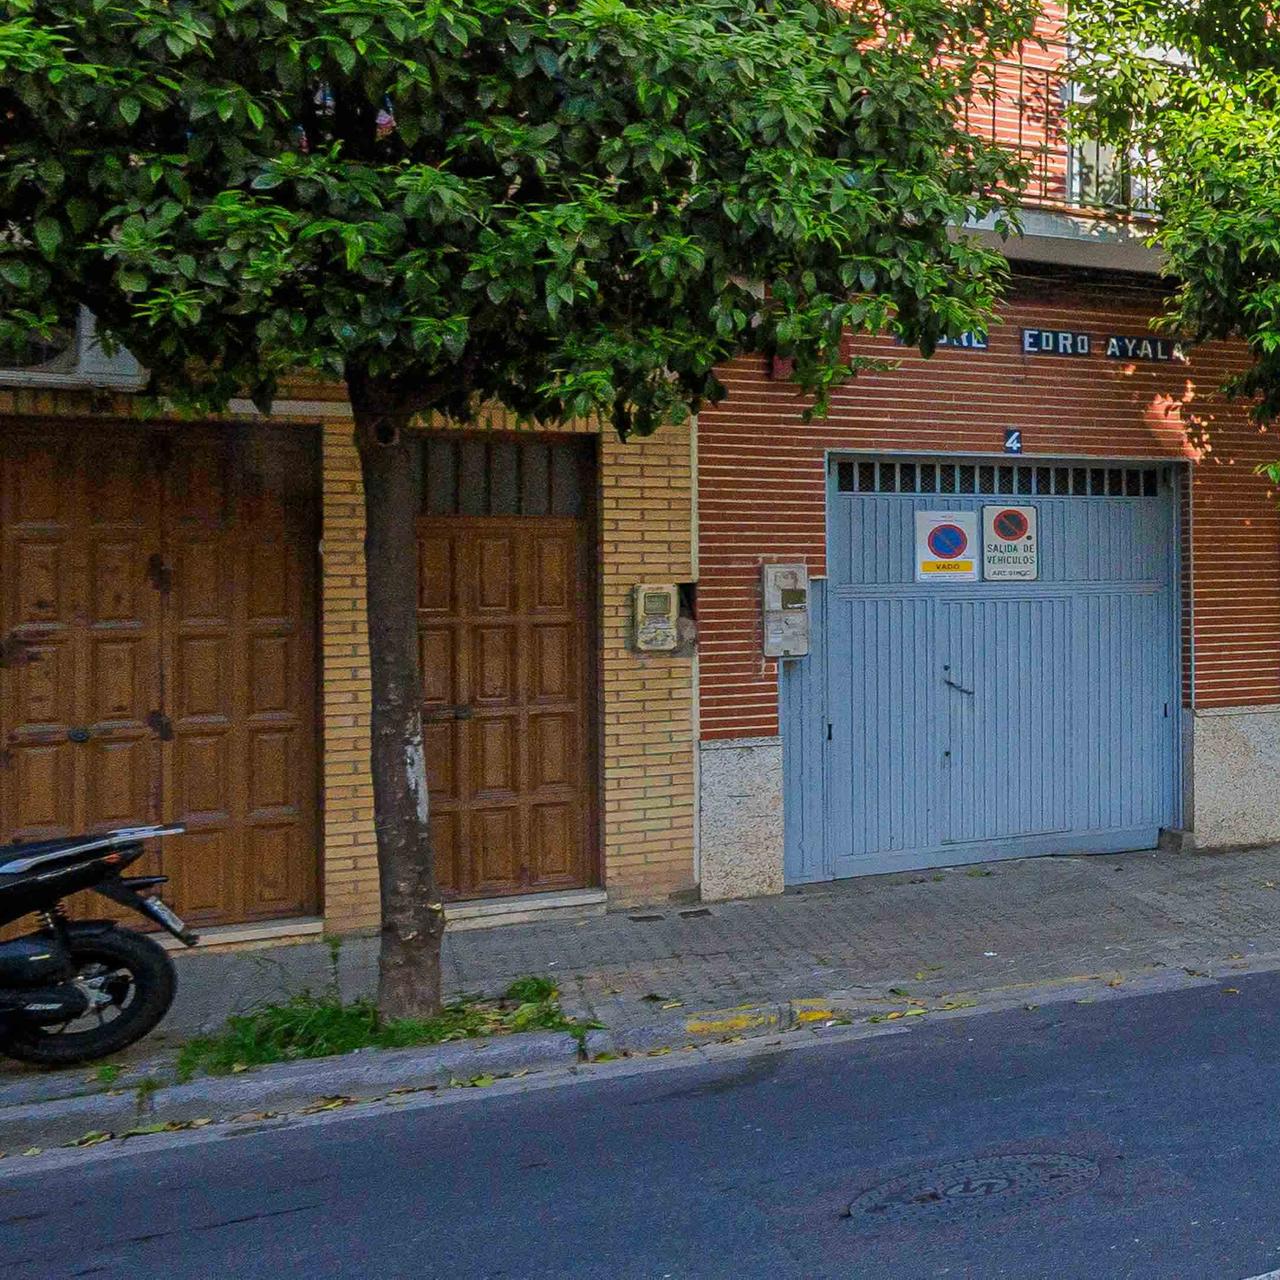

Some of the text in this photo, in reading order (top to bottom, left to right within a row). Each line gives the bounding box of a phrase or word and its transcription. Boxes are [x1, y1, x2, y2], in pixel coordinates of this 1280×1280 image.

[1106, 336, 1186, 361] AYALA
[1005, 431, 1021, 450] 4
[987, 543, 1035, 554] SALIDA DE
